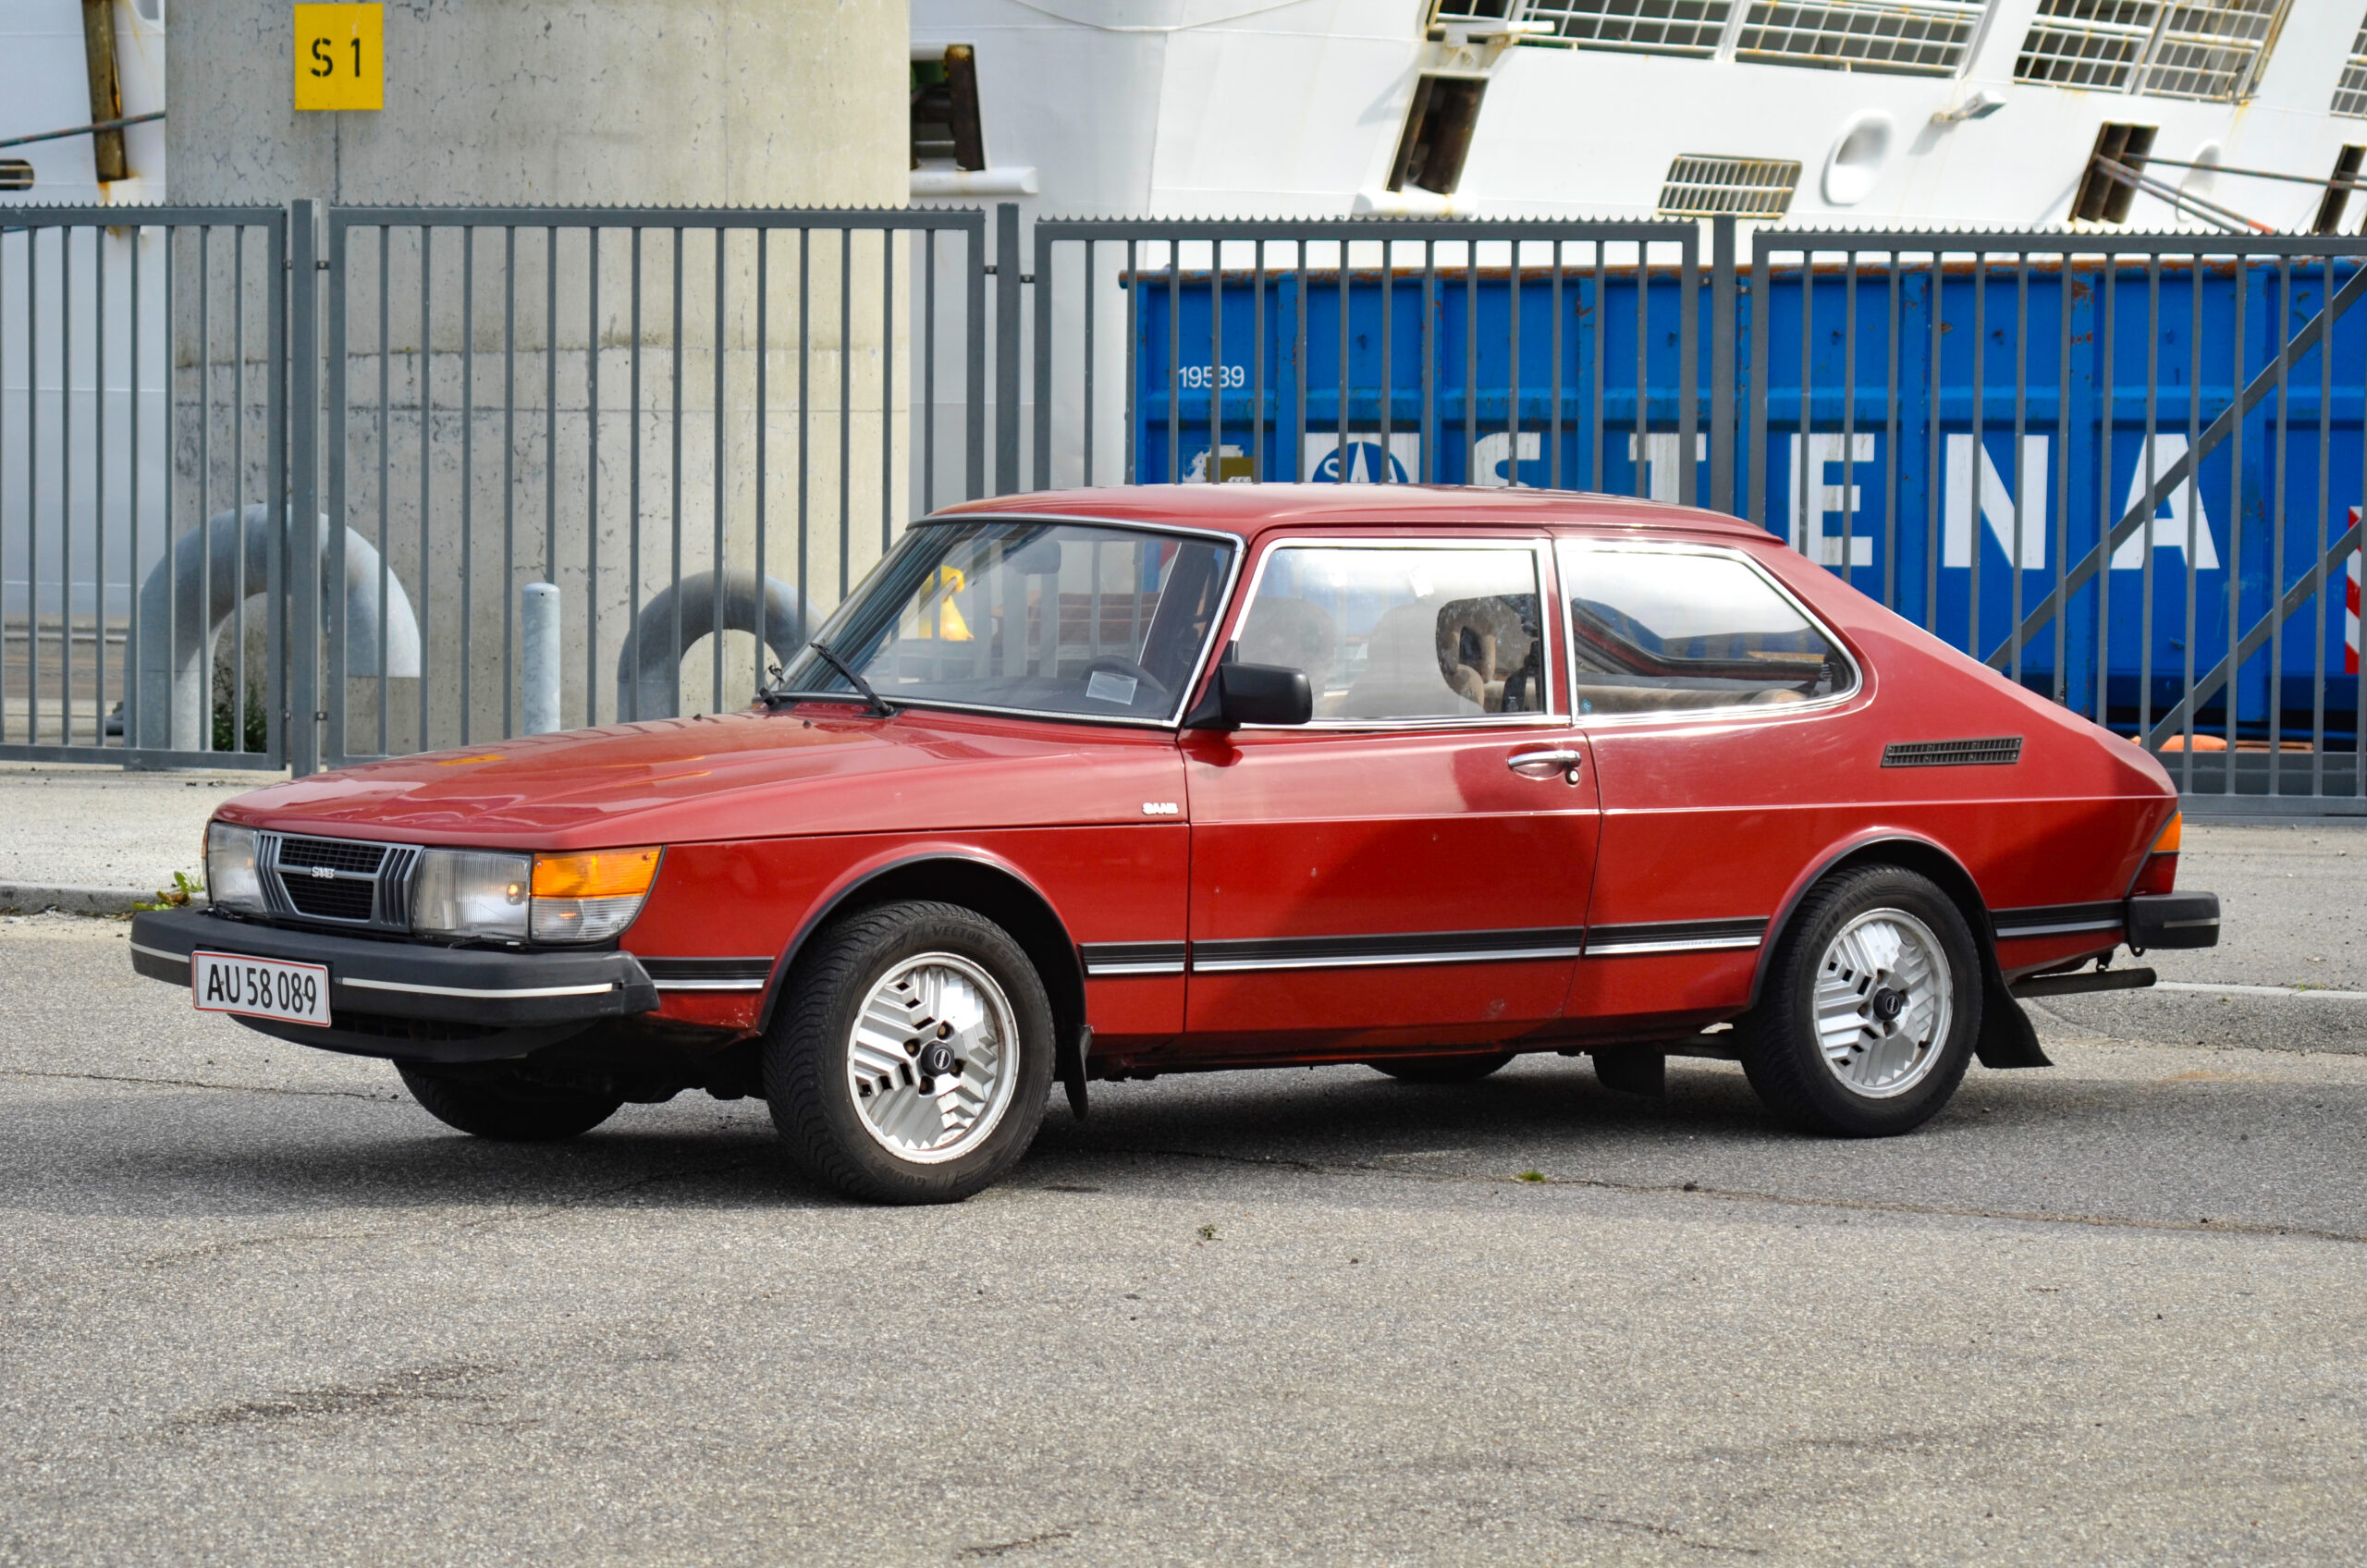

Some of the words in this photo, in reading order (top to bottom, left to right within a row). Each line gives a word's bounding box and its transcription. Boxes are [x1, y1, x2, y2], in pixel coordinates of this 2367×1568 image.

[311, 37, 333, 78] S
[350, 37, 361, 78] 1
[1179, 365, 1245, 388] 19539
[207, 963, 240, 1004] AU
[246, 967, 273, 1009] 58
[277, 971, 316, 1015] 089
